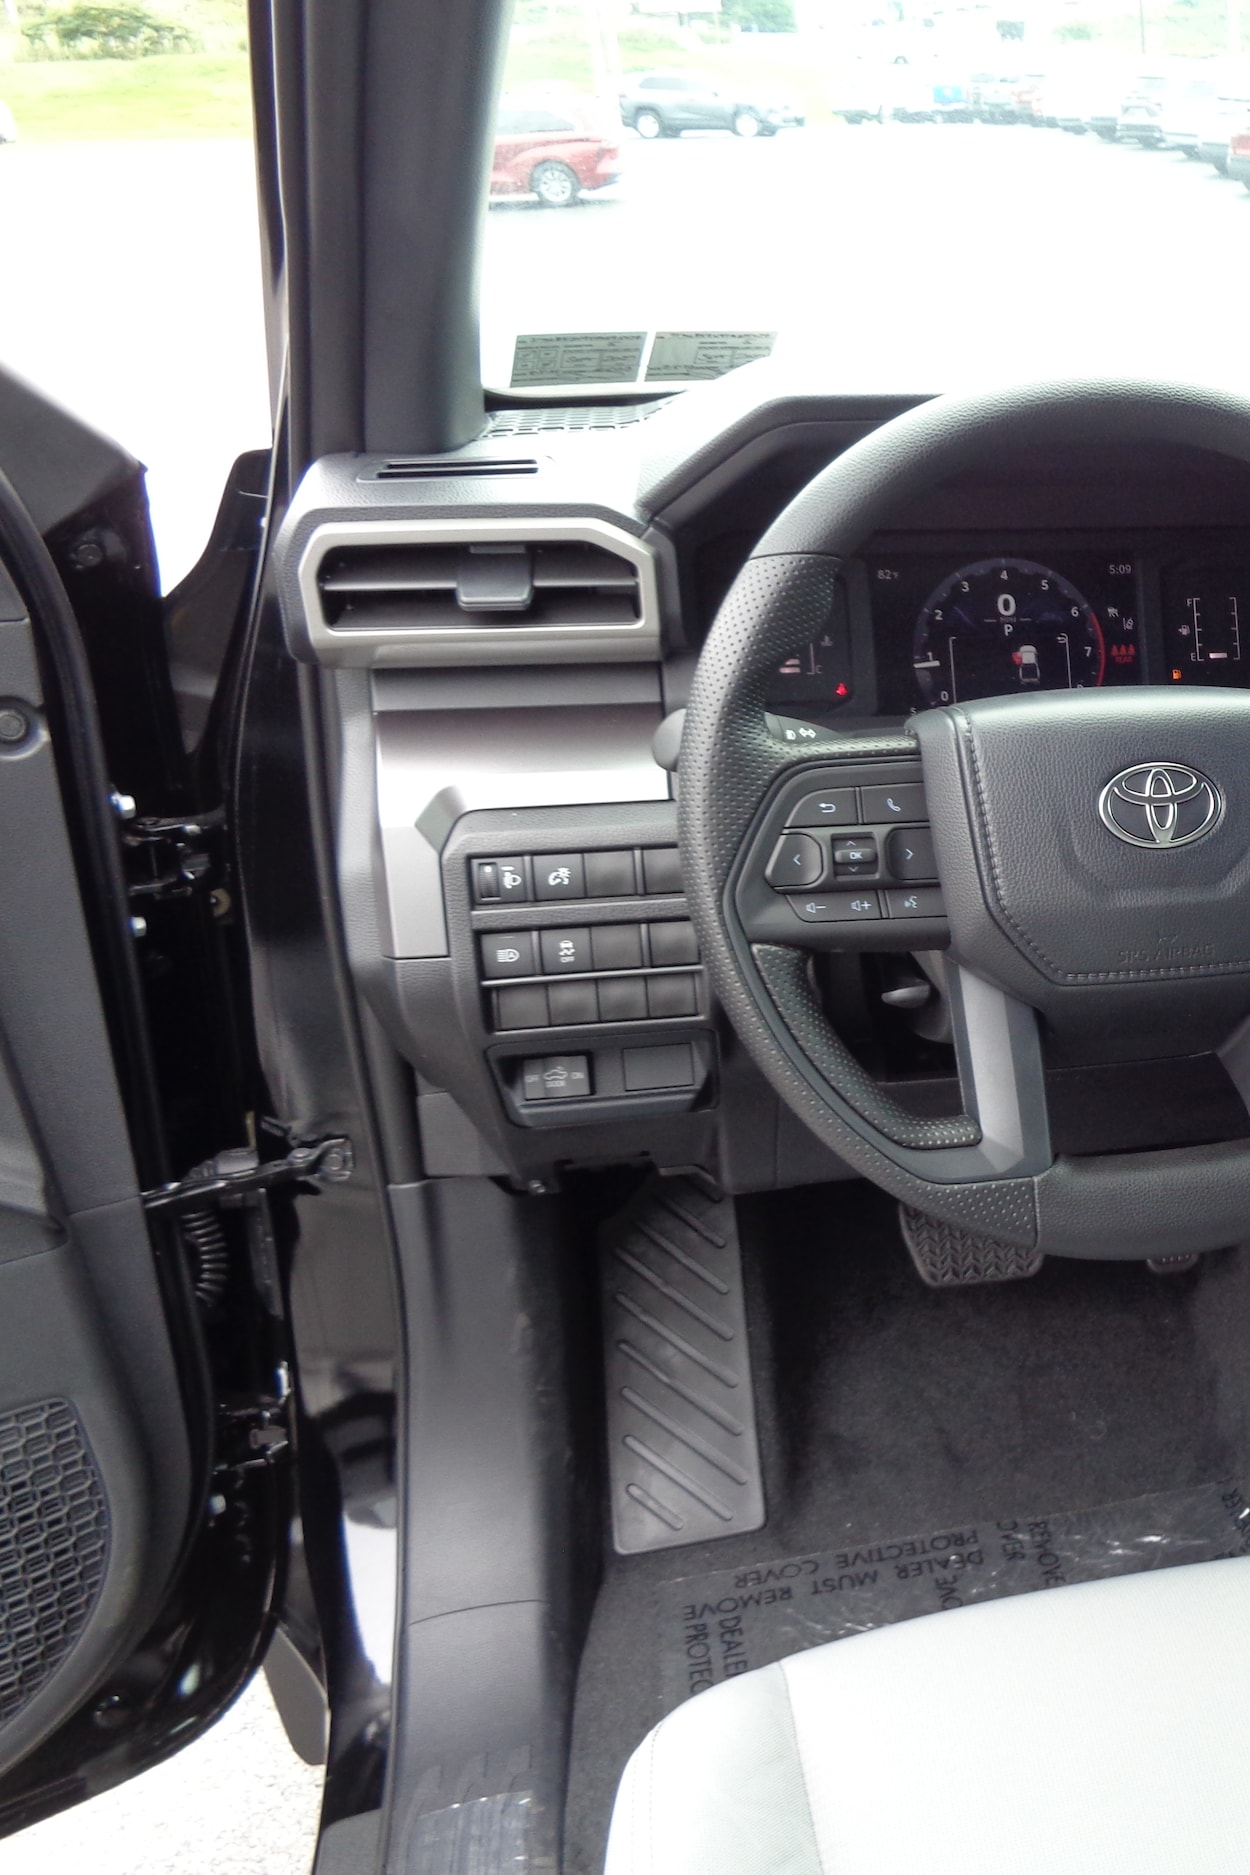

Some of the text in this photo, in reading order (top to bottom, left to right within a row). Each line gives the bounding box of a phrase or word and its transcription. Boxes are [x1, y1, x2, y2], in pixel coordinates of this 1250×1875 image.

[1000, 570, 1009, 581] 4
[1108, 564, 1132, 575] 5:09
[961, 581, 970, 592] 3
[1041, 579, 1050, 591] 5
[997, 593, 1017, 617] 0
[1186, 599, 1193, 607] F
[934, 609, 944, 621] 2
[1071, 607, 1080, 618] 6
[1004, 623, 1014, 636] P
[926, 651, 934, 662] 1
[1084, 646, 1093, 658] 7
[1190, 652, 1197, 662] E
[940, 690, 949, 702] 0
[733, 1529, 980, 1589] PROTECTIVE COVER
[683, 1549, 985, 1621] DEALER MUST REMOVE
